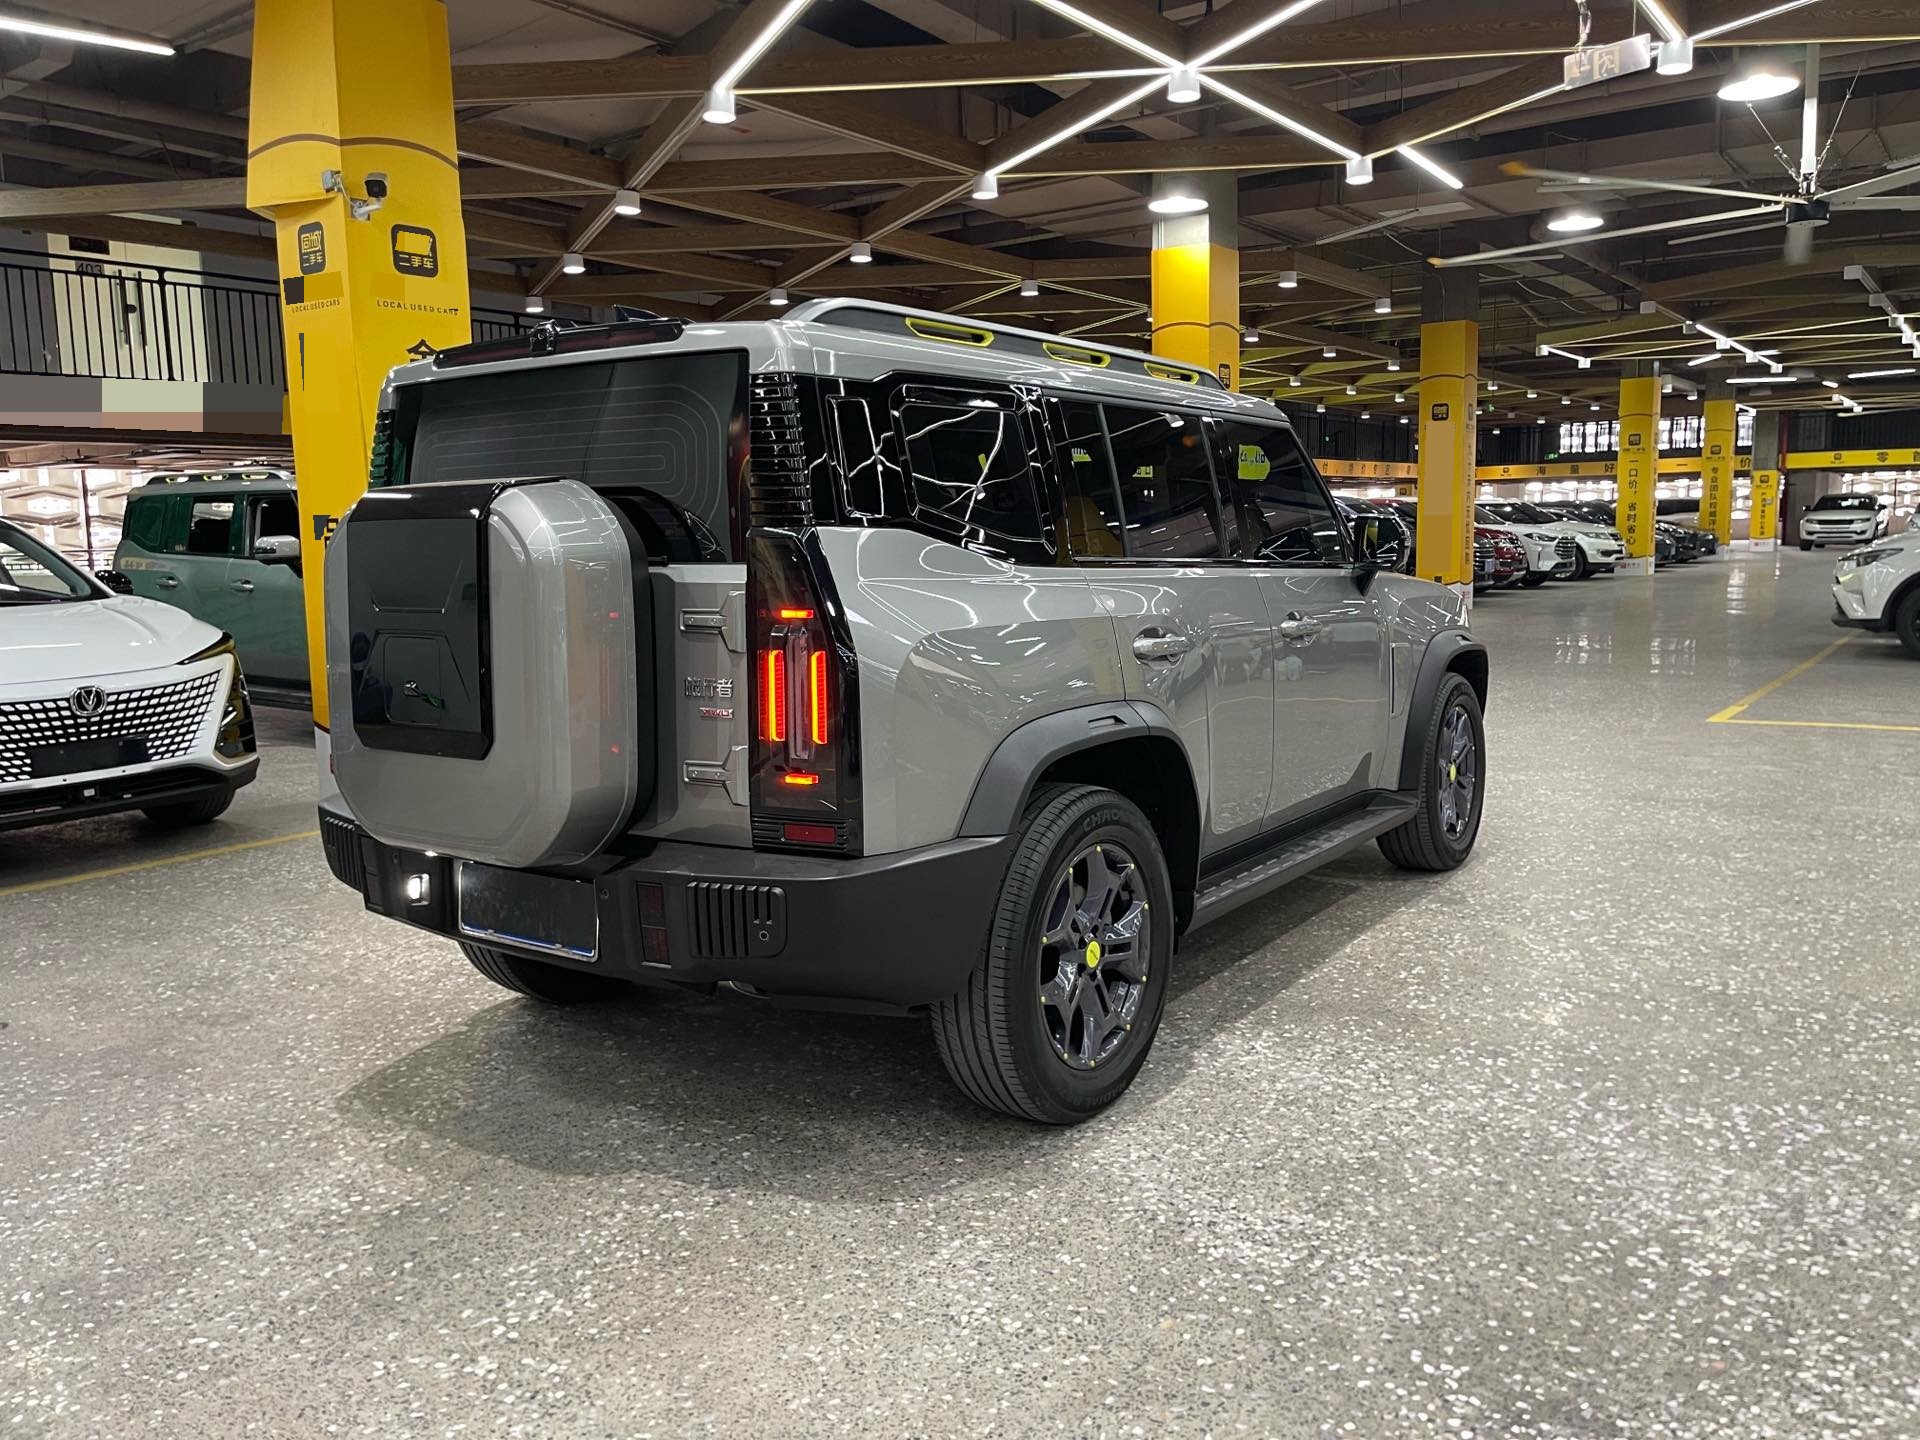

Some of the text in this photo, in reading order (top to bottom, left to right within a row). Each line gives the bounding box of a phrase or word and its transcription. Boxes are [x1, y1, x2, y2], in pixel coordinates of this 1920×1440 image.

[302, 252, 324, 267] 二手车
[399, 254, 435, 269] 二手车
[291, 298, 341, 314] LOCAL USED CARS
[376, 299, 408, 310] LOCAL
[410, 303, 435, 313] USED
